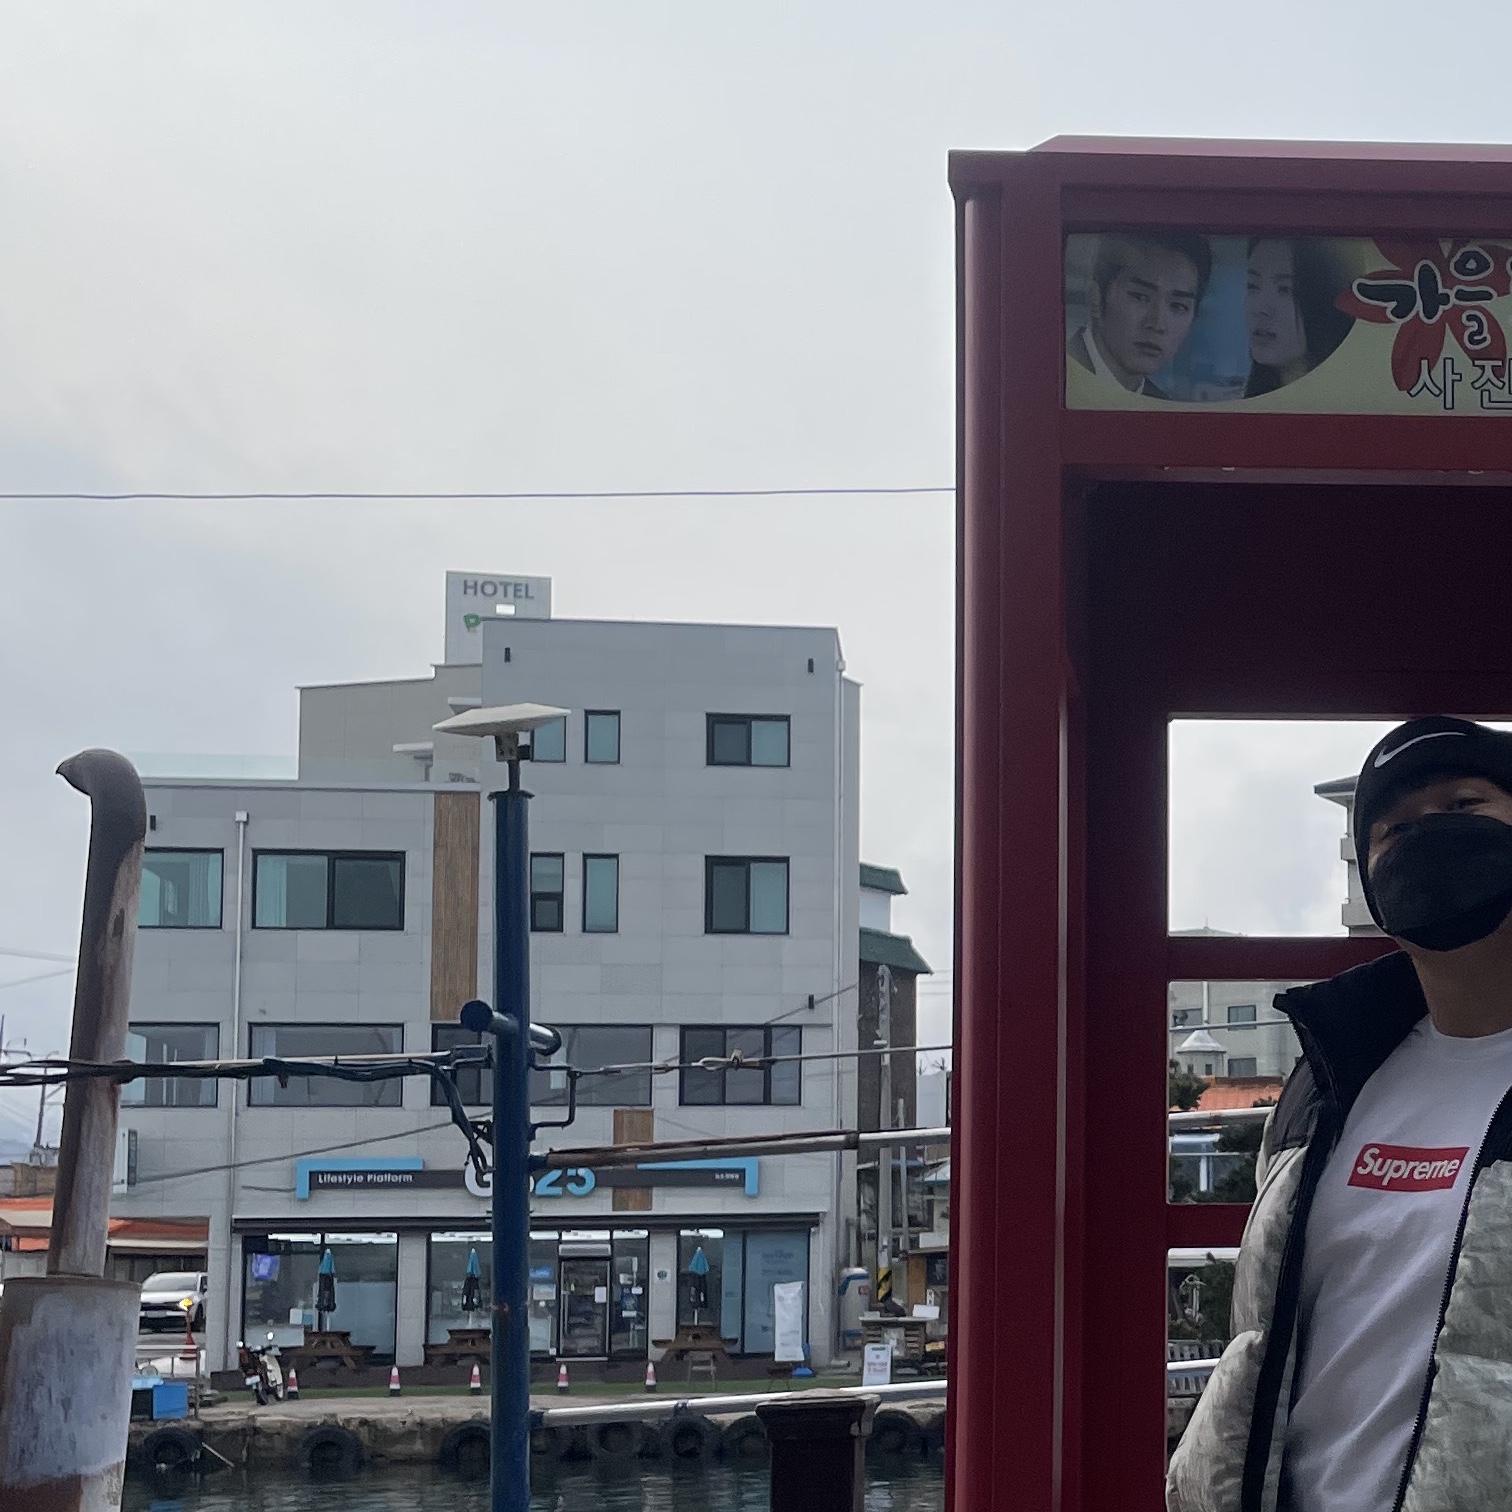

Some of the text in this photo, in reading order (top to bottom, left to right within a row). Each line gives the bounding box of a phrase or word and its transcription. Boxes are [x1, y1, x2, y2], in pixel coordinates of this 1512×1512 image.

[463, 579, 535, 600] HOTEL
[317, 1172, 413, 1185] Lifestyle Platform
[465, 1160, 596, 1198] G25
[1356, 1147, 1461, 1187] Supreme
